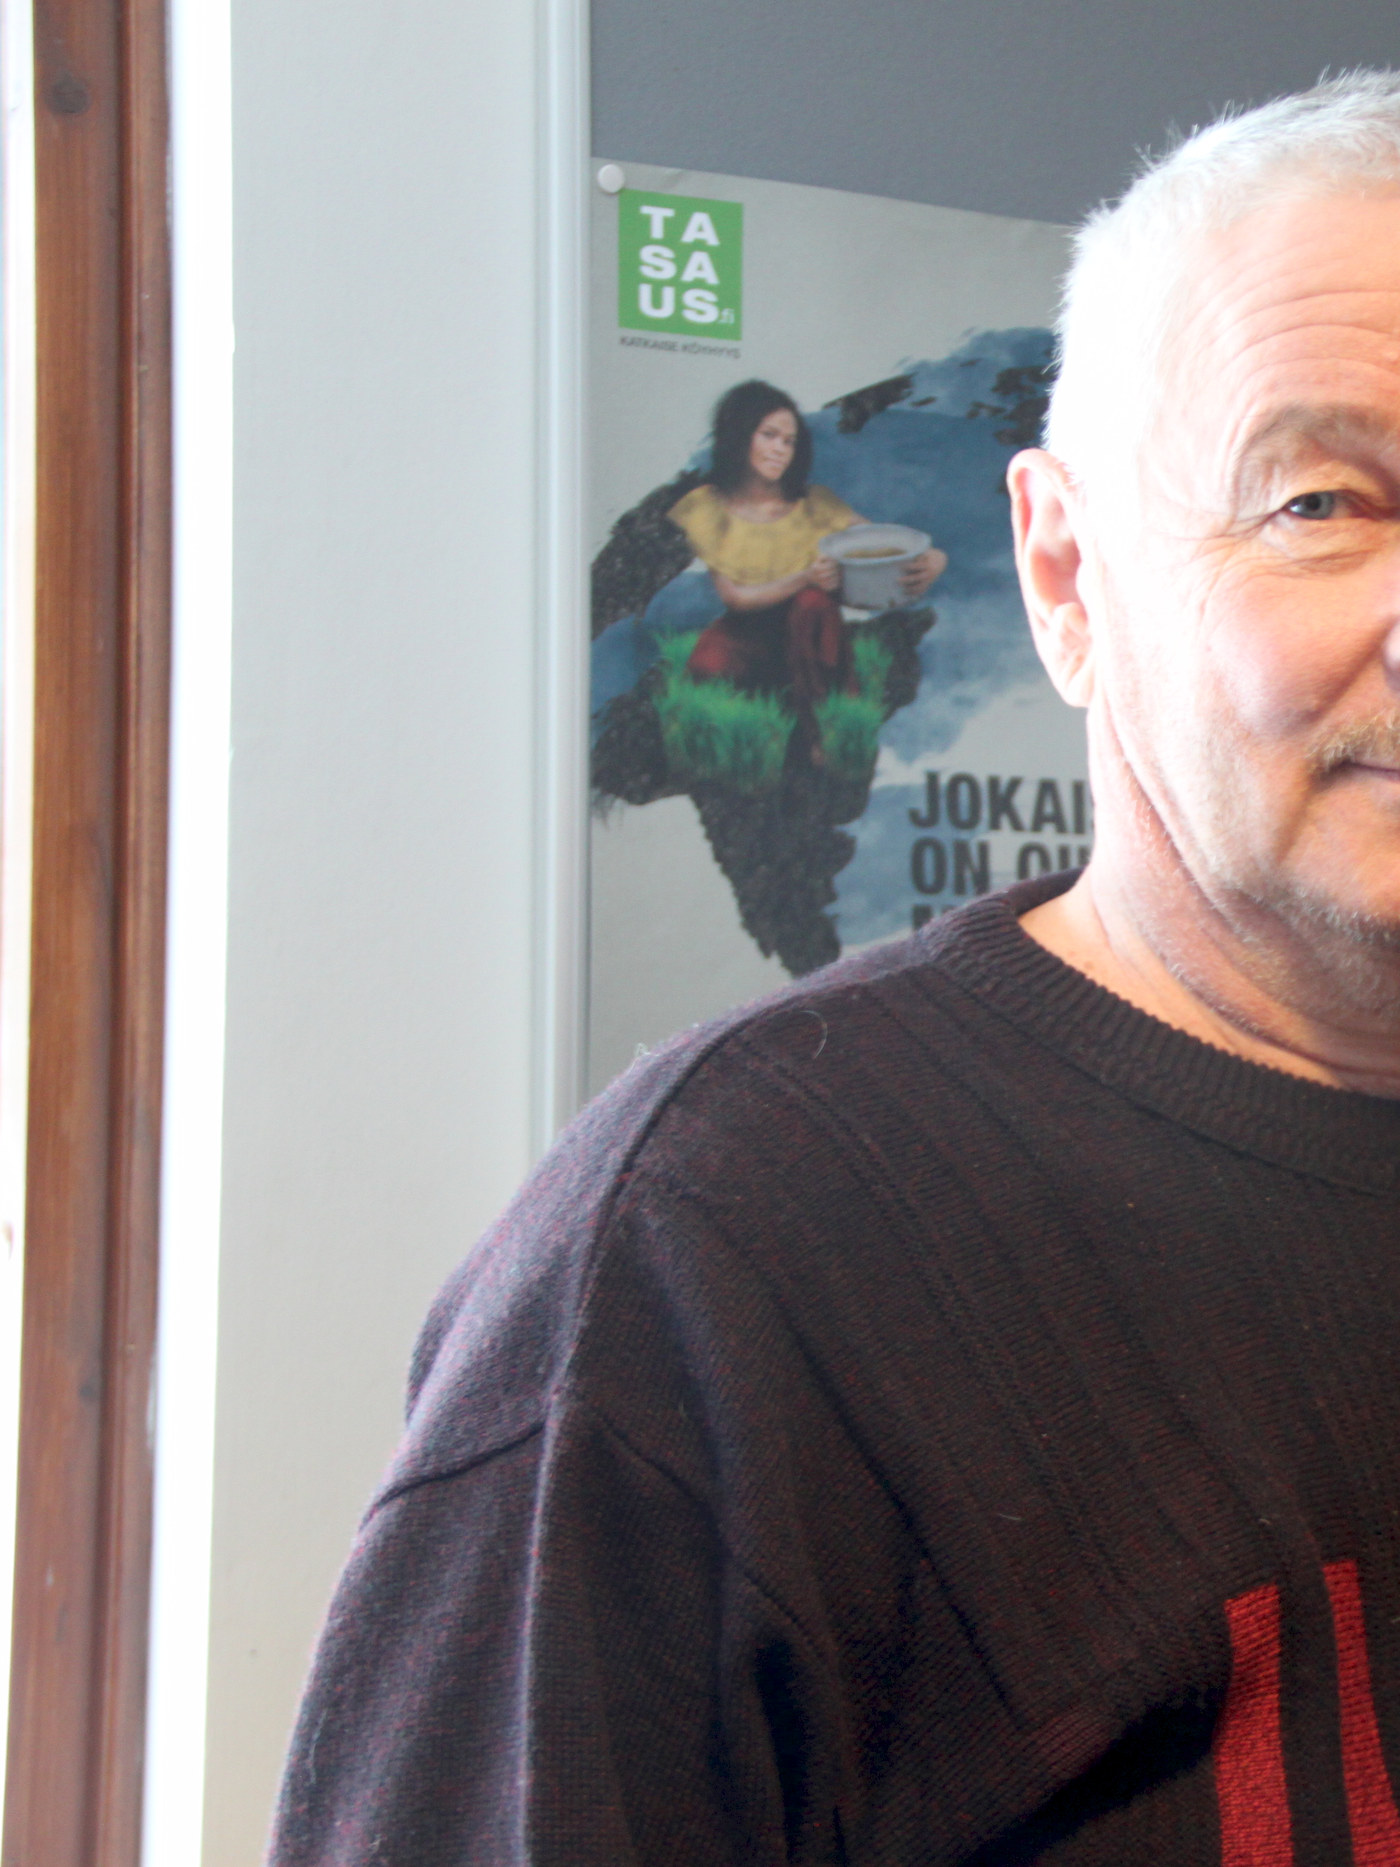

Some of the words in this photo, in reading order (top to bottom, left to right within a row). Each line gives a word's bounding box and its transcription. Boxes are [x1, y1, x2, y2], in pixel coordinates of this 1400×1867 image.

[639, 205, 720, 246] TA
[639, 244, 720, 285] SA
[908, 770, 1094, 836] JOKAI
[910, 836, 990, 896] ON
